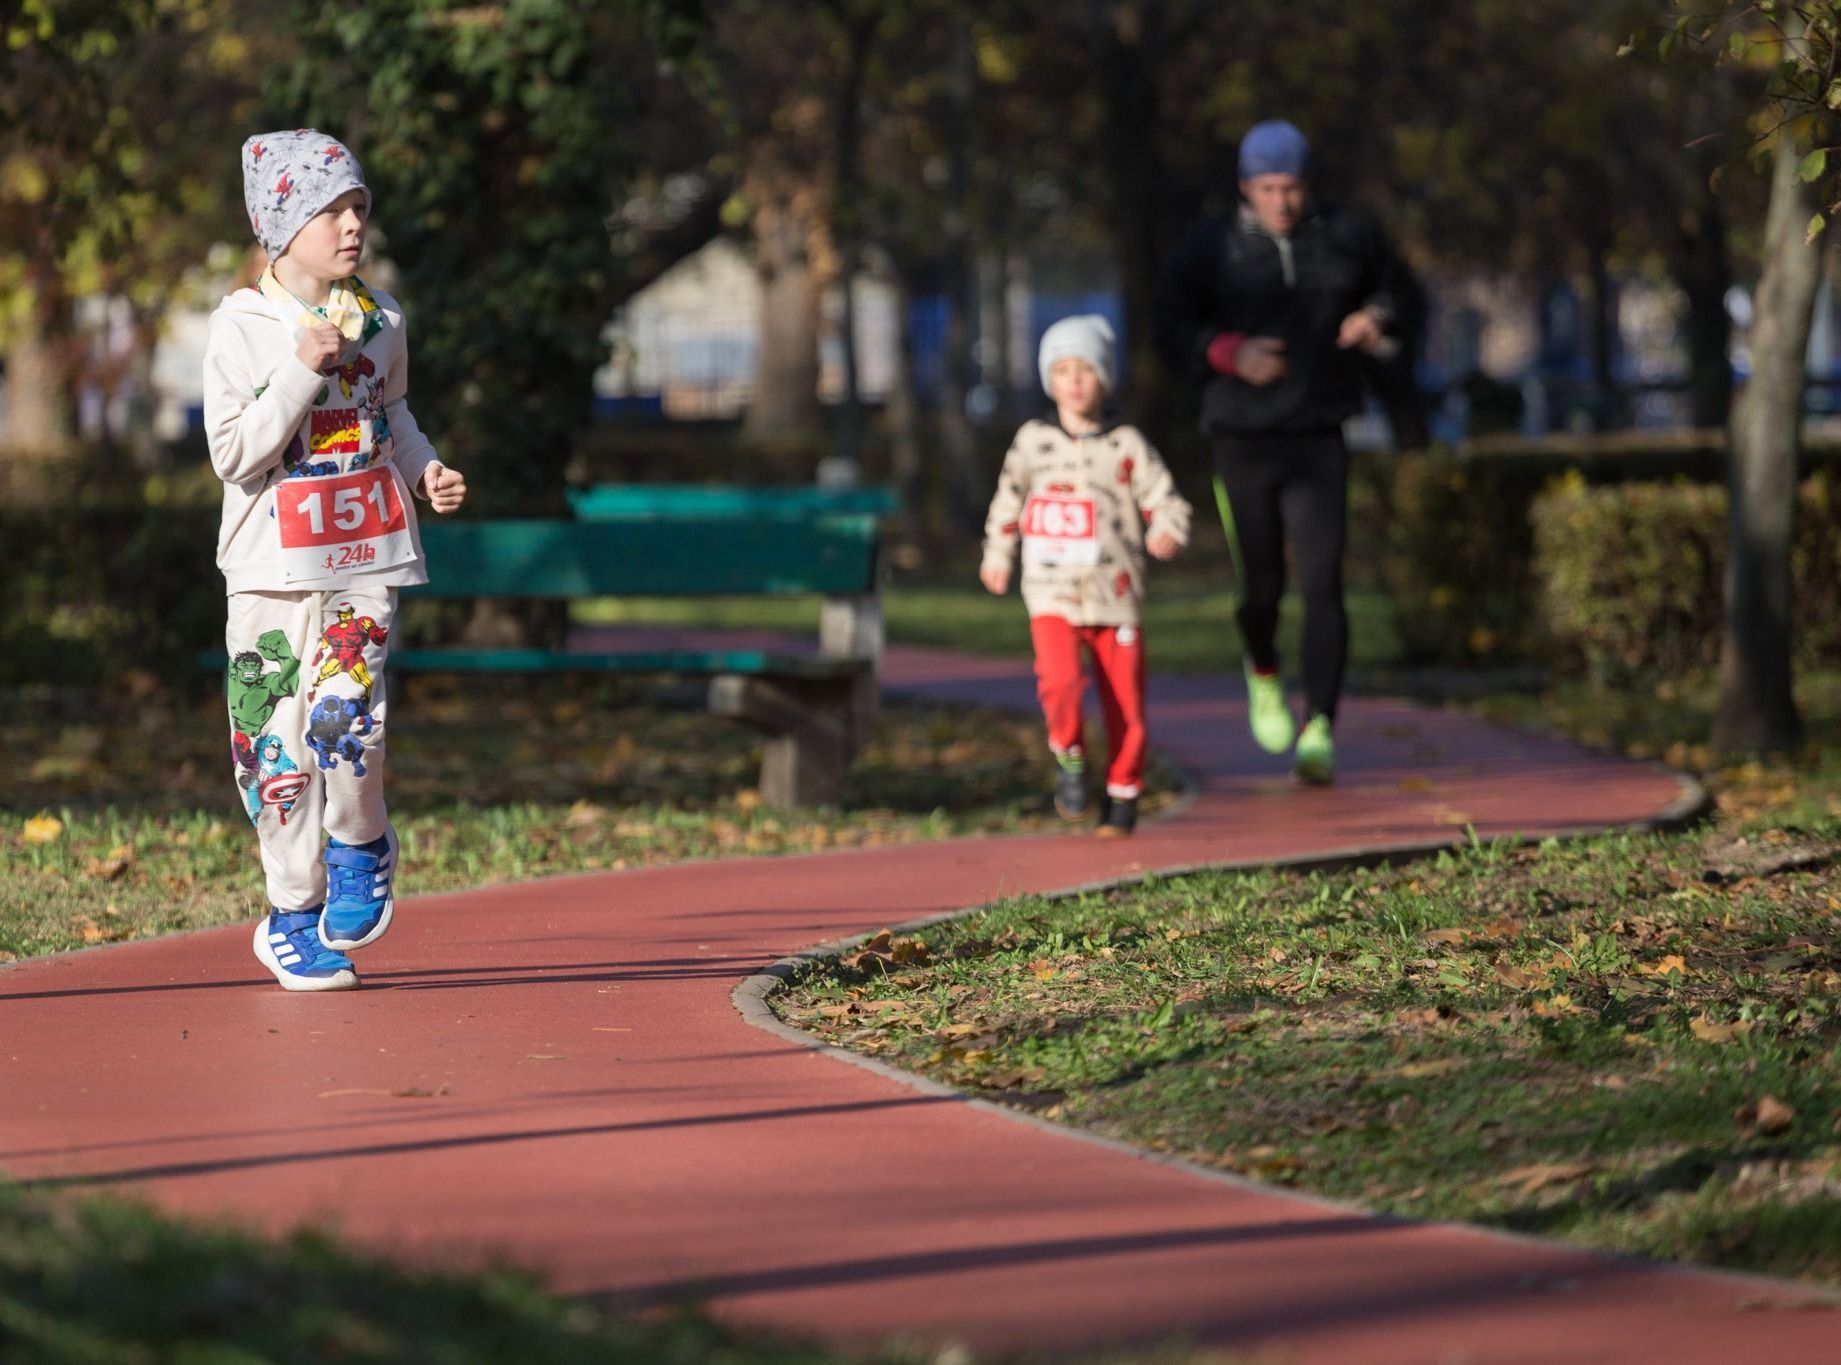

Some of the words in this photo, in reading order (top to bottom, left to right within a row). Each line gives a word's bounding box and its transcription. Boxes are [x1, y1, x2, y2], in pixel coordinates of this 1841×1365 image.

[311, 408, 359, 434] MARVEL
[297, 480, 389, 535] 151
[1031, 501, 1088, 536] 163
[337, 543, 376, 566] 24h
